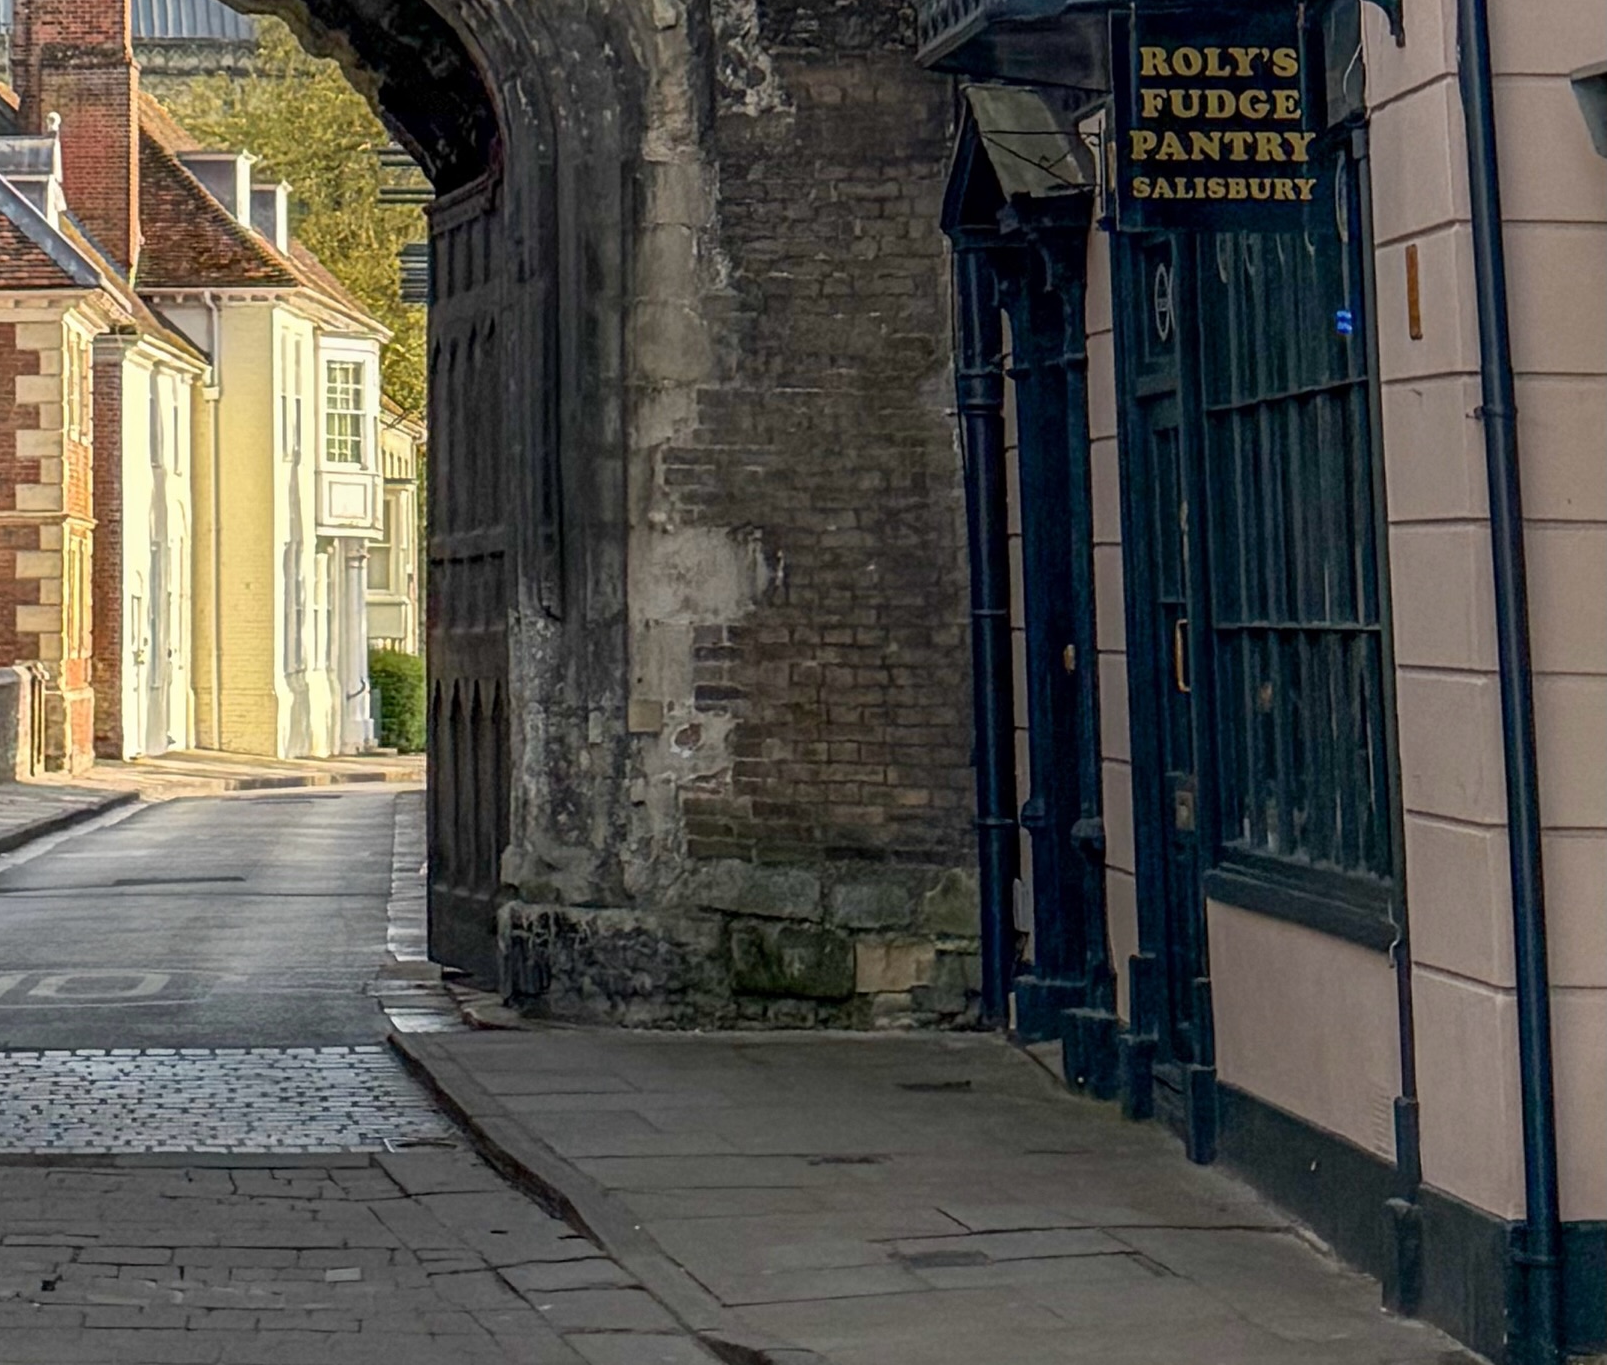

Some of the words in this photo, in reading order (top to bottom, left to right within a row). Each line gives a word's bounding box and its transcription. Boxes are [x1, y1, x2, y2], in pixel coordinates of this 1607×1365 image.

[1139, 46, 1299, 78] ROLY'S
[1140, 88, 1302, 120] FUDGE
[1129, 130, 1317, 162] PANTRY
[1132, 177, 1317, 201] SALISBURY
